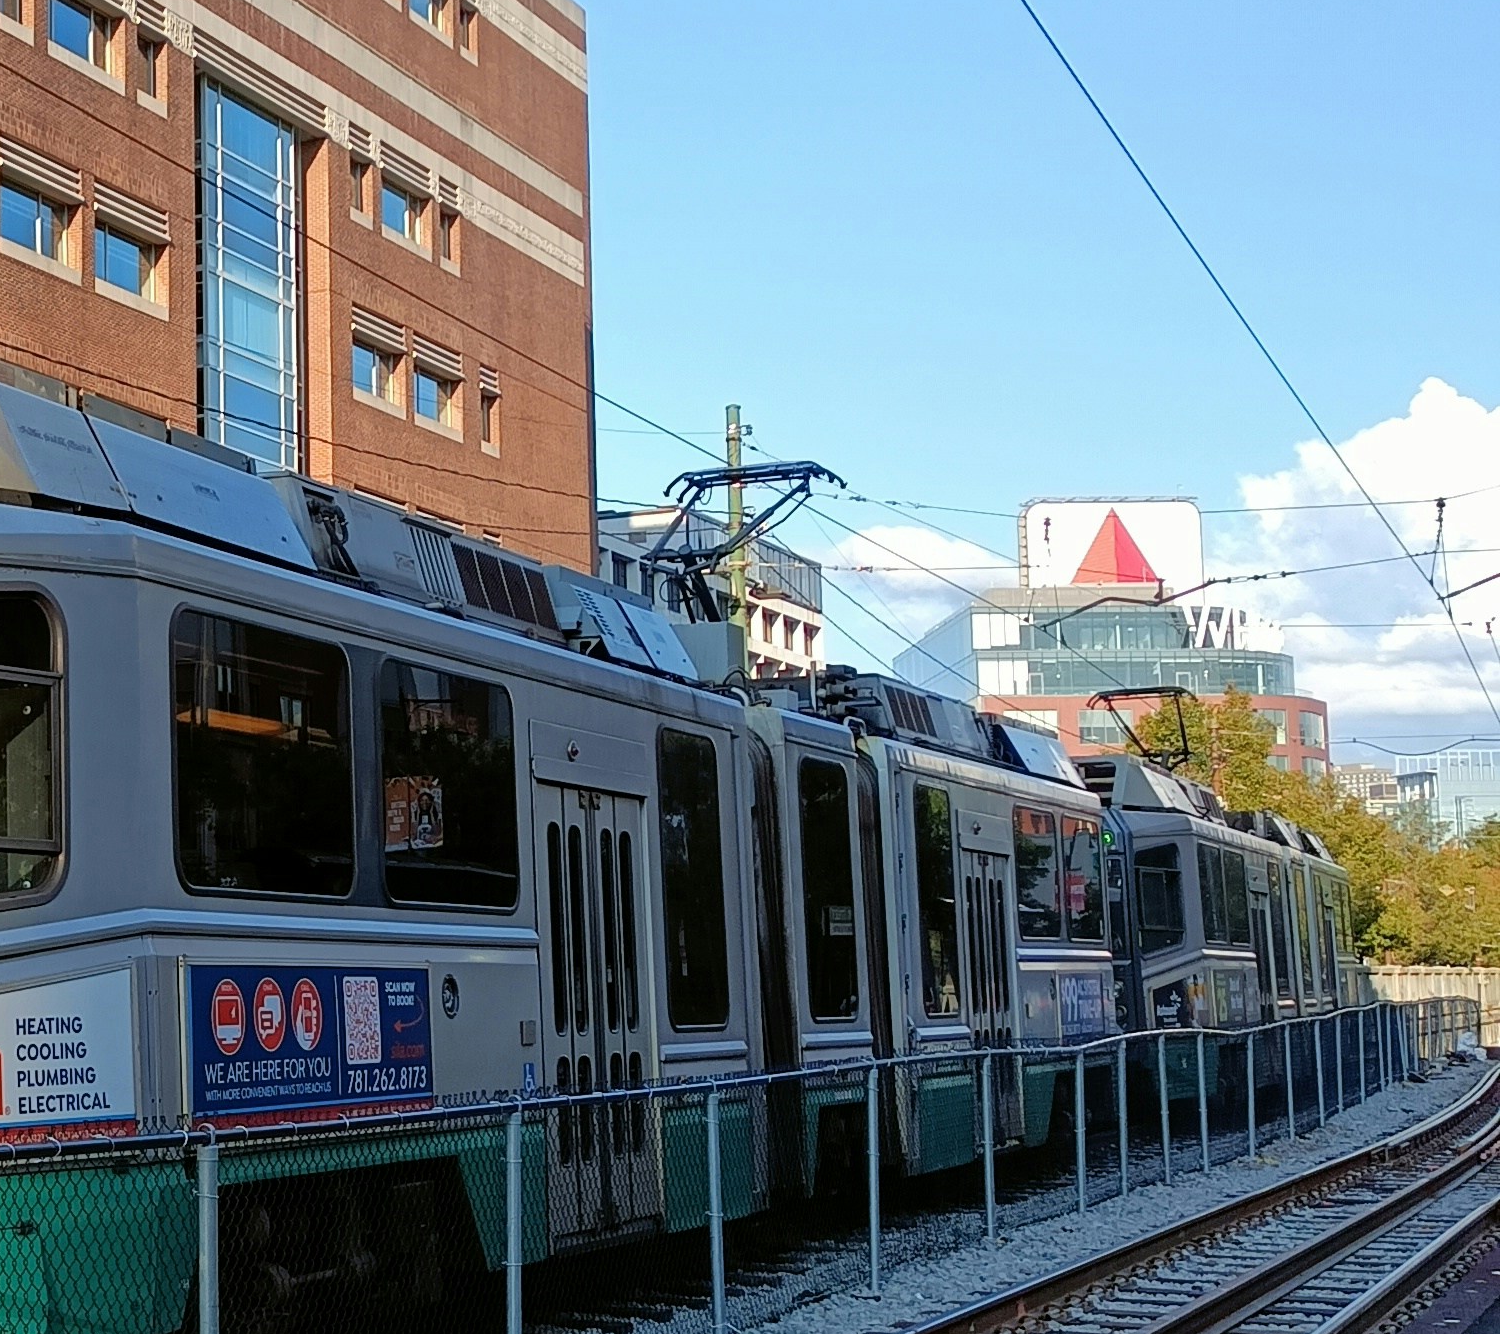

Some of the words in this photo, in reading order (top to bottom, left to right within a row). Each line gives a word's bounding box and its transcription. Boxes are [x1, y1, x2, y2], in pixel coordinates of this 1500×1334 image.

[385, 982, 400, 993] SCAN
[401, 982, 415, 992] NOW
[388, 995, 396, 1006] TO
[16, 1016, 83, 1036] HEATING
[16, 1041, 87, 1061] COOLING
[391, 1042, 425, 1059] sila.com
[17, 1067, 97, 1087] PLUMBING
[205, 1063, 224, 1084] WE
[227, 1062, 250, 1083] ARE
[252, 1060, 281, 1081] HERE
[284, 1059, 306, 1078] FOR
[308, 1057, 331, 1077] YOU
[347, 1066, 427, 1094] 781.262.8173
[206, 1090, 221, 1102] WITH
[222, 1089, 241, 1100] MORE
[241, 1085, 279, 1100] CONVENIENT
[279, 1084, 296, 1096] WAYS
[296, 1084, 304, 1094] TO
[304, 1083, 323, 1094] REACH
[323, 1082, 331, 1093] US
[18, 1091, 111, 1115] ELECTRICAL
